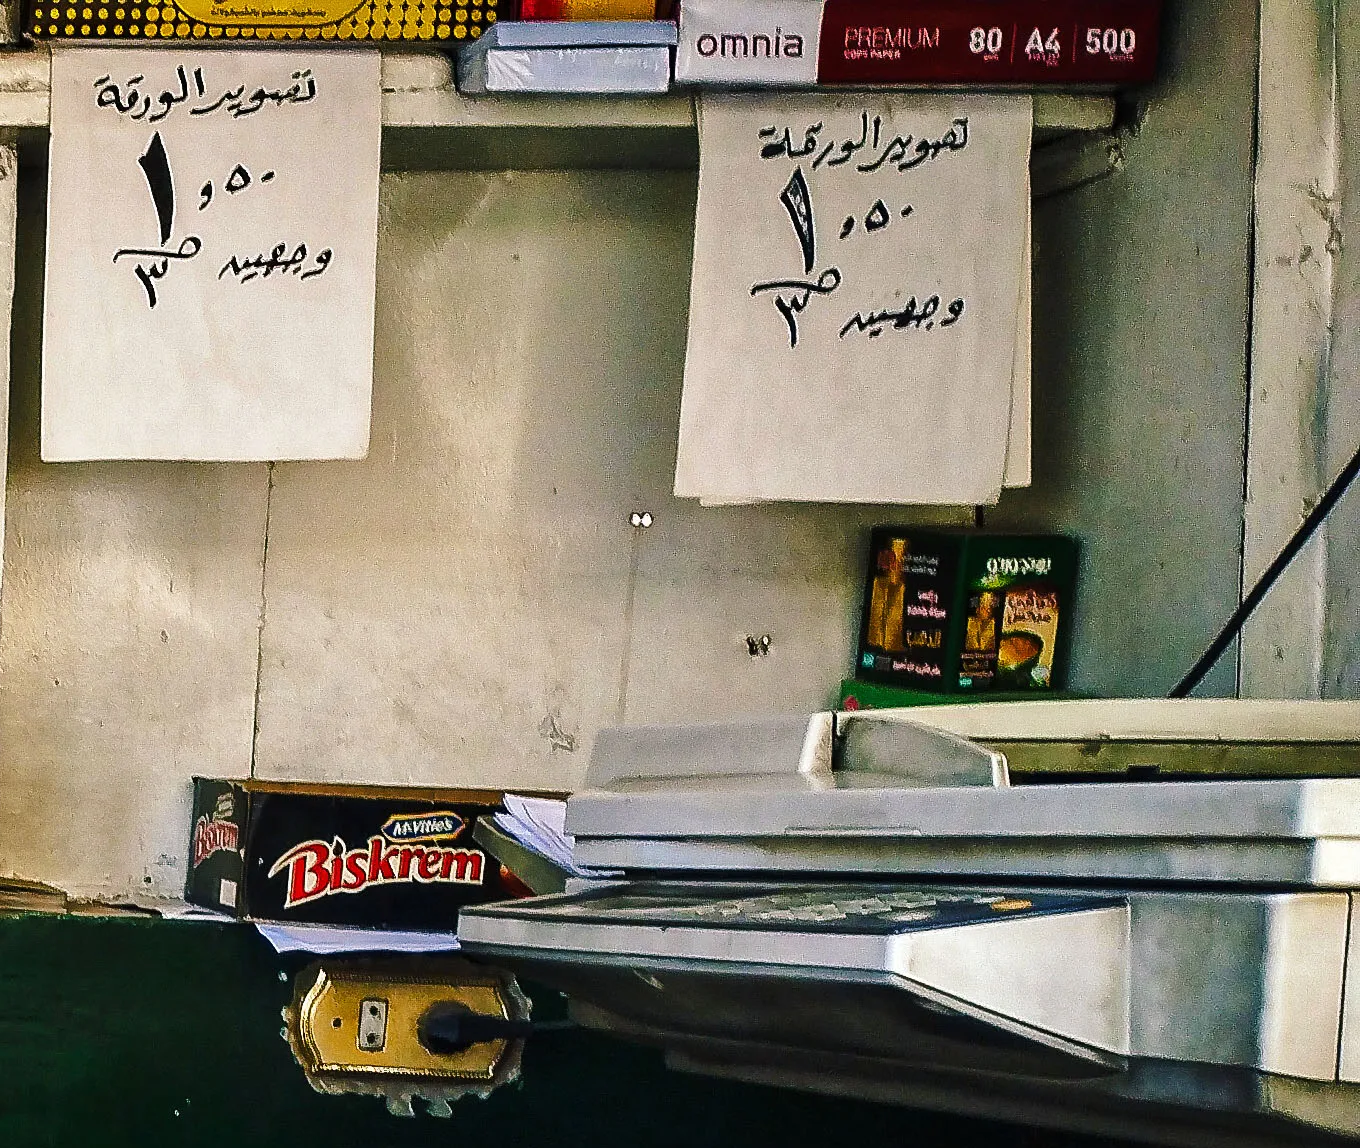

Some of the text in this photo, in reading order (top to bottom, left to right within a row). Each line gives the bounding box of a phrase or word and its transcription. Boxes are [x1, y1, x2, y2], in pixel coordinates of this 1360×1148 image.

[696, 26, 804, 58] omnia
[843, 26, 1136, 54] PREMIUM 80 A4 500
[93, 64, 317, 124] تصوير الورقة
[268, 834, 487, 910] Biskrem
